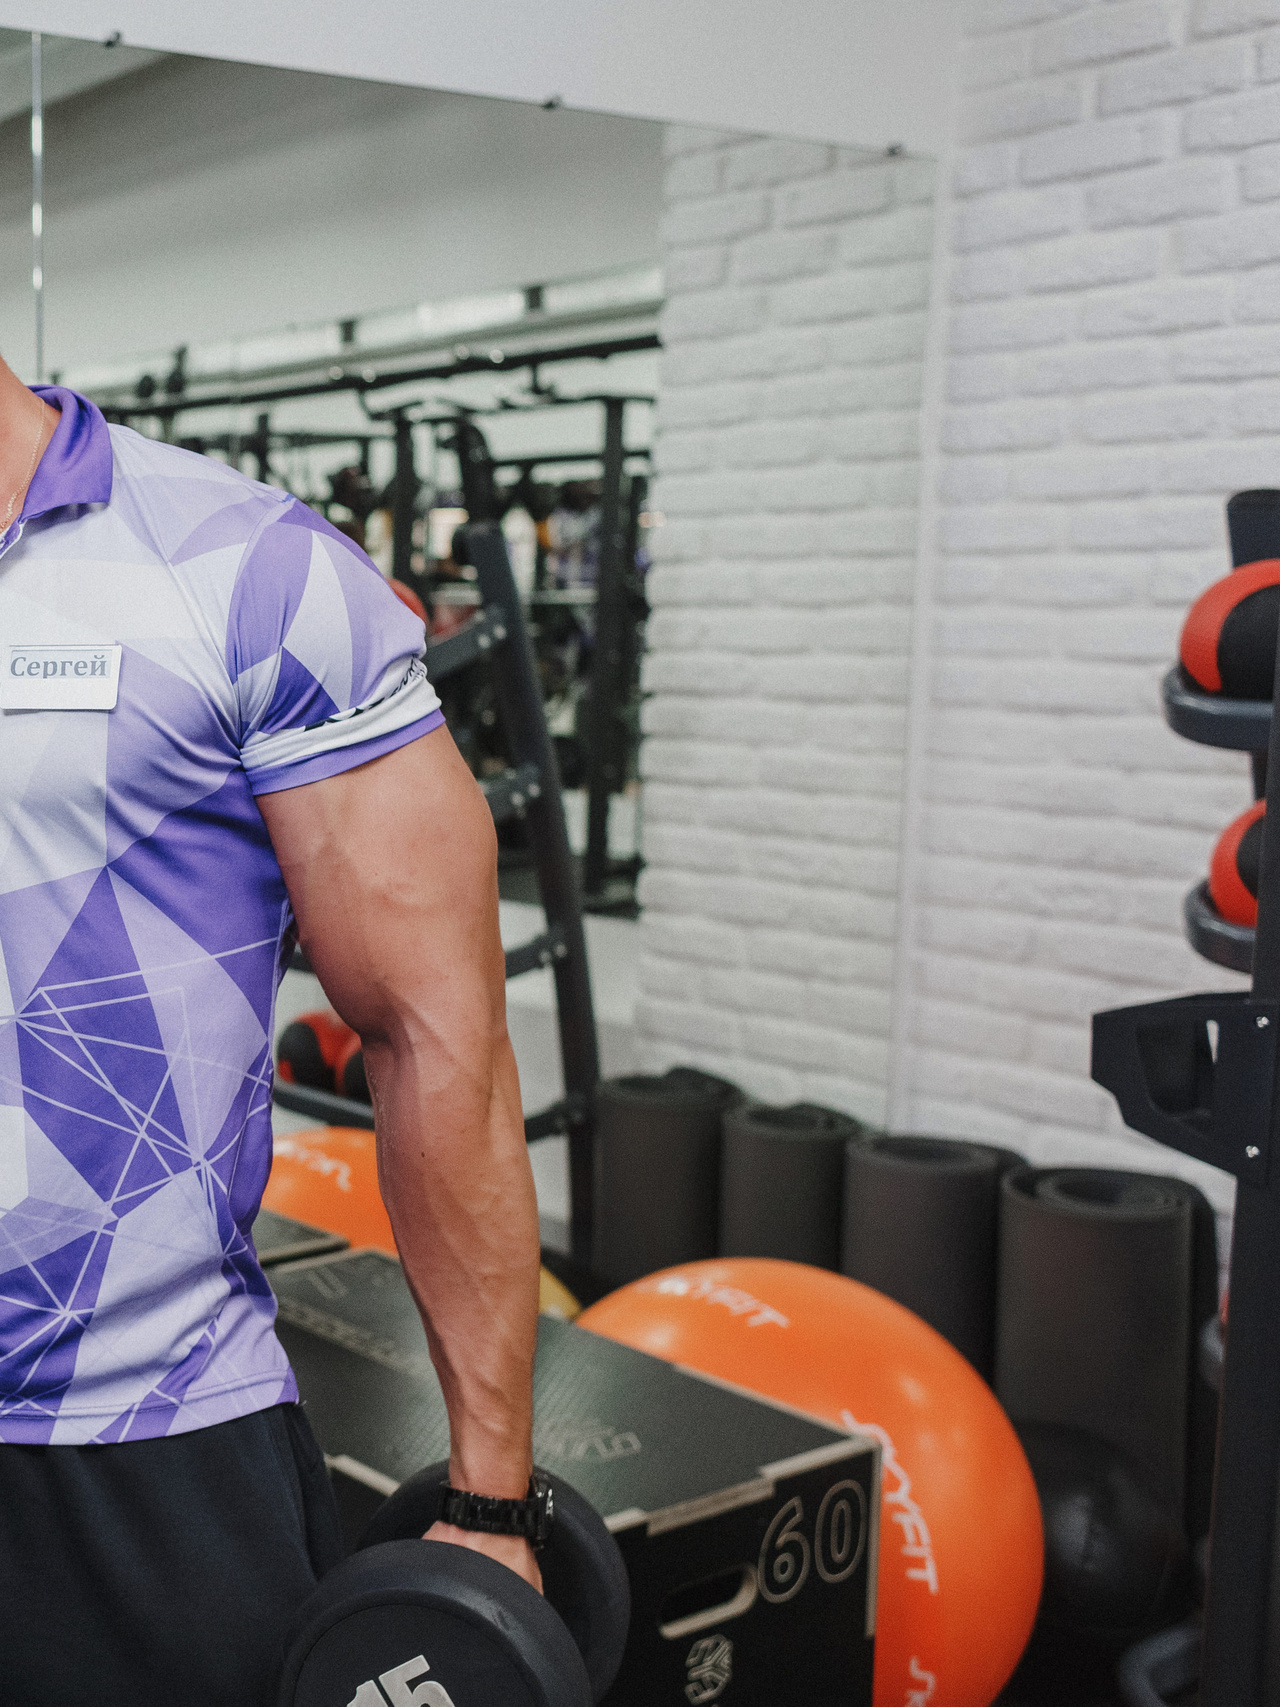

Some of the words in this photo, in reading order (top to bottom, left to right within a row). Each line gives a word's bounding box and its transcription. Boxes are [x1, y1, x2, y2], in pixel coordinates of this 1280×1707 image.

[10, 654, 108, 679] Сергей
[757, 1478, 868, 1604] 60
[346, 1654, 456, 1707] 5
